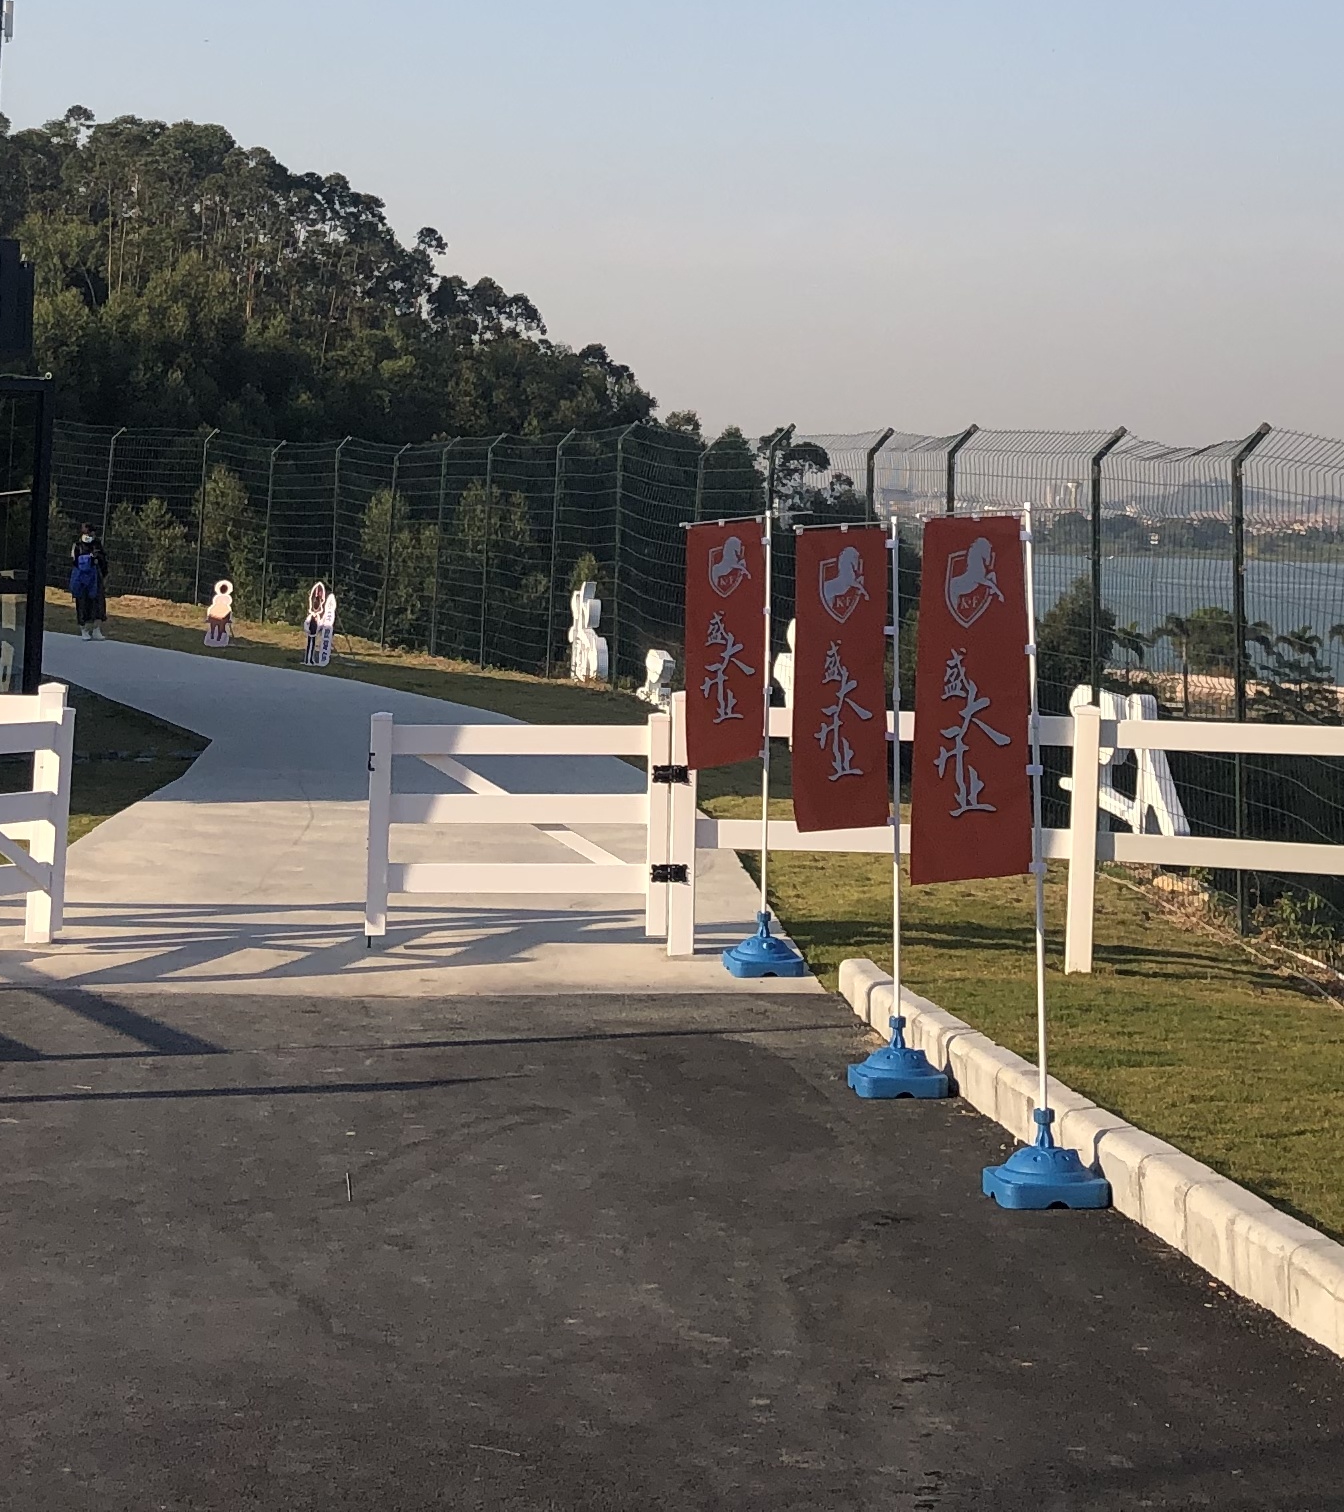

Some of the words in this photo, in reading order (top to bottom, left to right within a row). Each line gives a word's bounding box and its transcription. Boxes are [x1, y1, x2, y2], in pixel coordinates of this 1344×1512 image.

[700, 610, 756, 724] 盛大开业
[814, 640, 873, 781] 盛大开业
[933, 647, 1012, 817] 盛大开业
